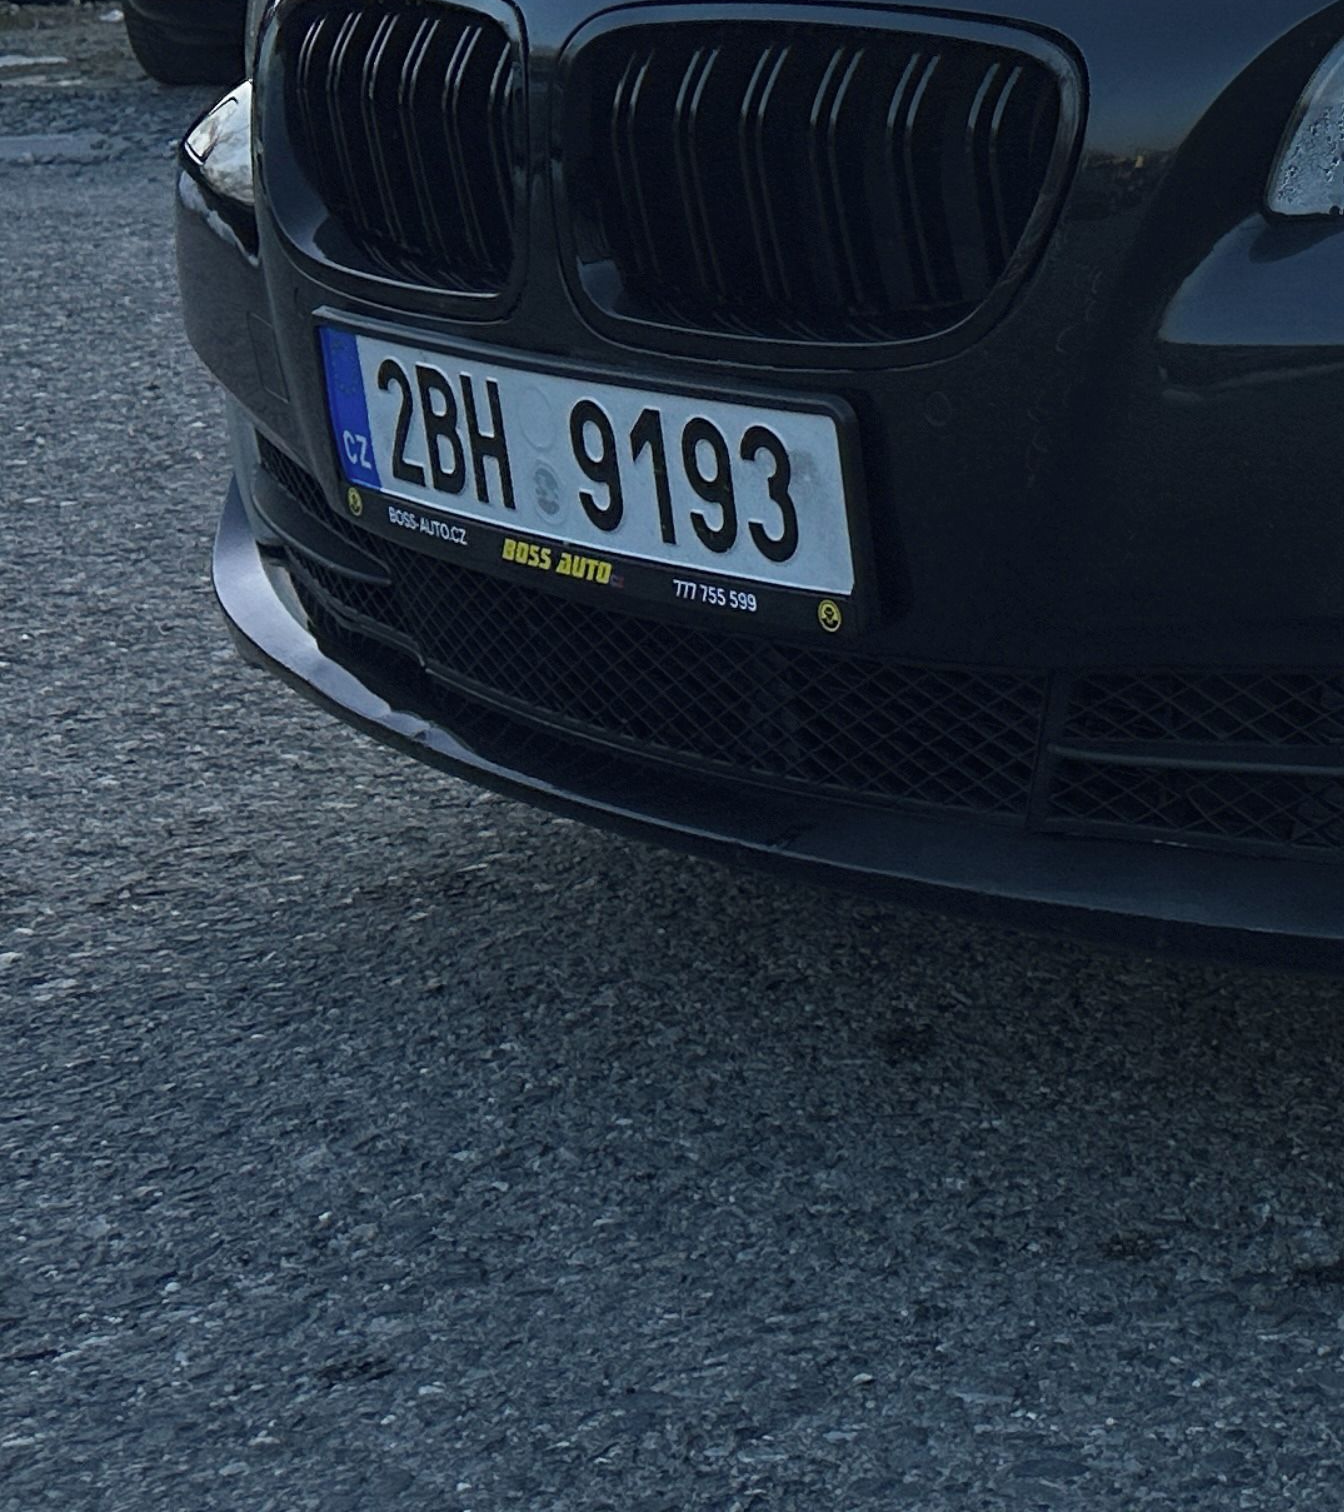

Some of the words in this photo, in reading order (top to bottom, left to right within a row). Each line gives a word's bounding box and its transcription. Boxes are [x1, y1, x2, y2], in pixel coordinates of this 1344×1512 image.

[343, 430, 372, 470] CZ
[377, 358, 516, 510] 2BH
[569, 399, 799, 562] 9193
[388, 506, 468, 546] BOSS-AUTO.CZ
[502, 538, 551, 570] BOSS
[556, 552, 613, 584] AUTO
[673, 579, 696, 600] 777
[700, 584, 726, 606] 755
[730, 590, 757, 612] 599
